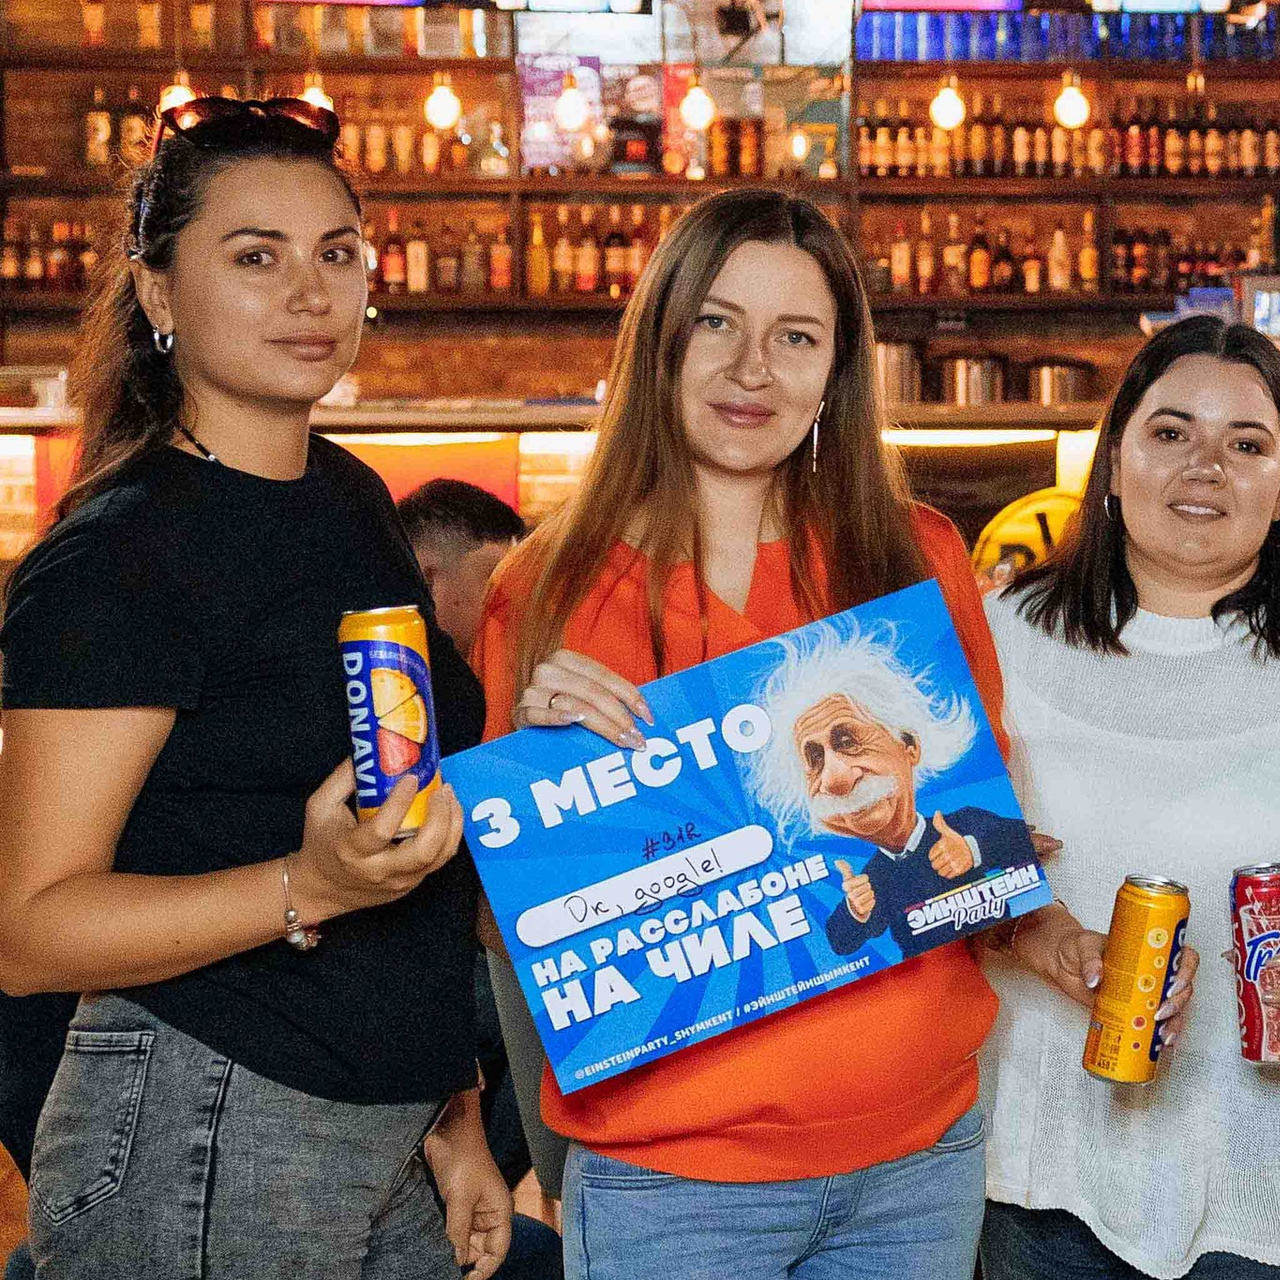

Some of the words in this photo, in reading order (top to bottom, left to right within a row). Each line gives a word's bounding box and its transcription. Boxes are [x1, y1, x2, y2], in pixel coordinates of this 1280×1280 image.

[343, 651, 378, 798] DONAVI
[471, 798, 520, 848] 3
[530, 703, 771, 829] МЕСТО
[531, 950, 588, 988] НА
[589, 853, 829, 966] РАССЛАБОНЕ
[634, 848, 724, 916] google!
[951, 897, 1005, 931] Party
[541, 964, 641, 1032] НА
[646, 894, 811, 984] ЧИЛЕ
[574, 1010, 733, 1080] @EINSTEINPARTY_SHYMKENT
